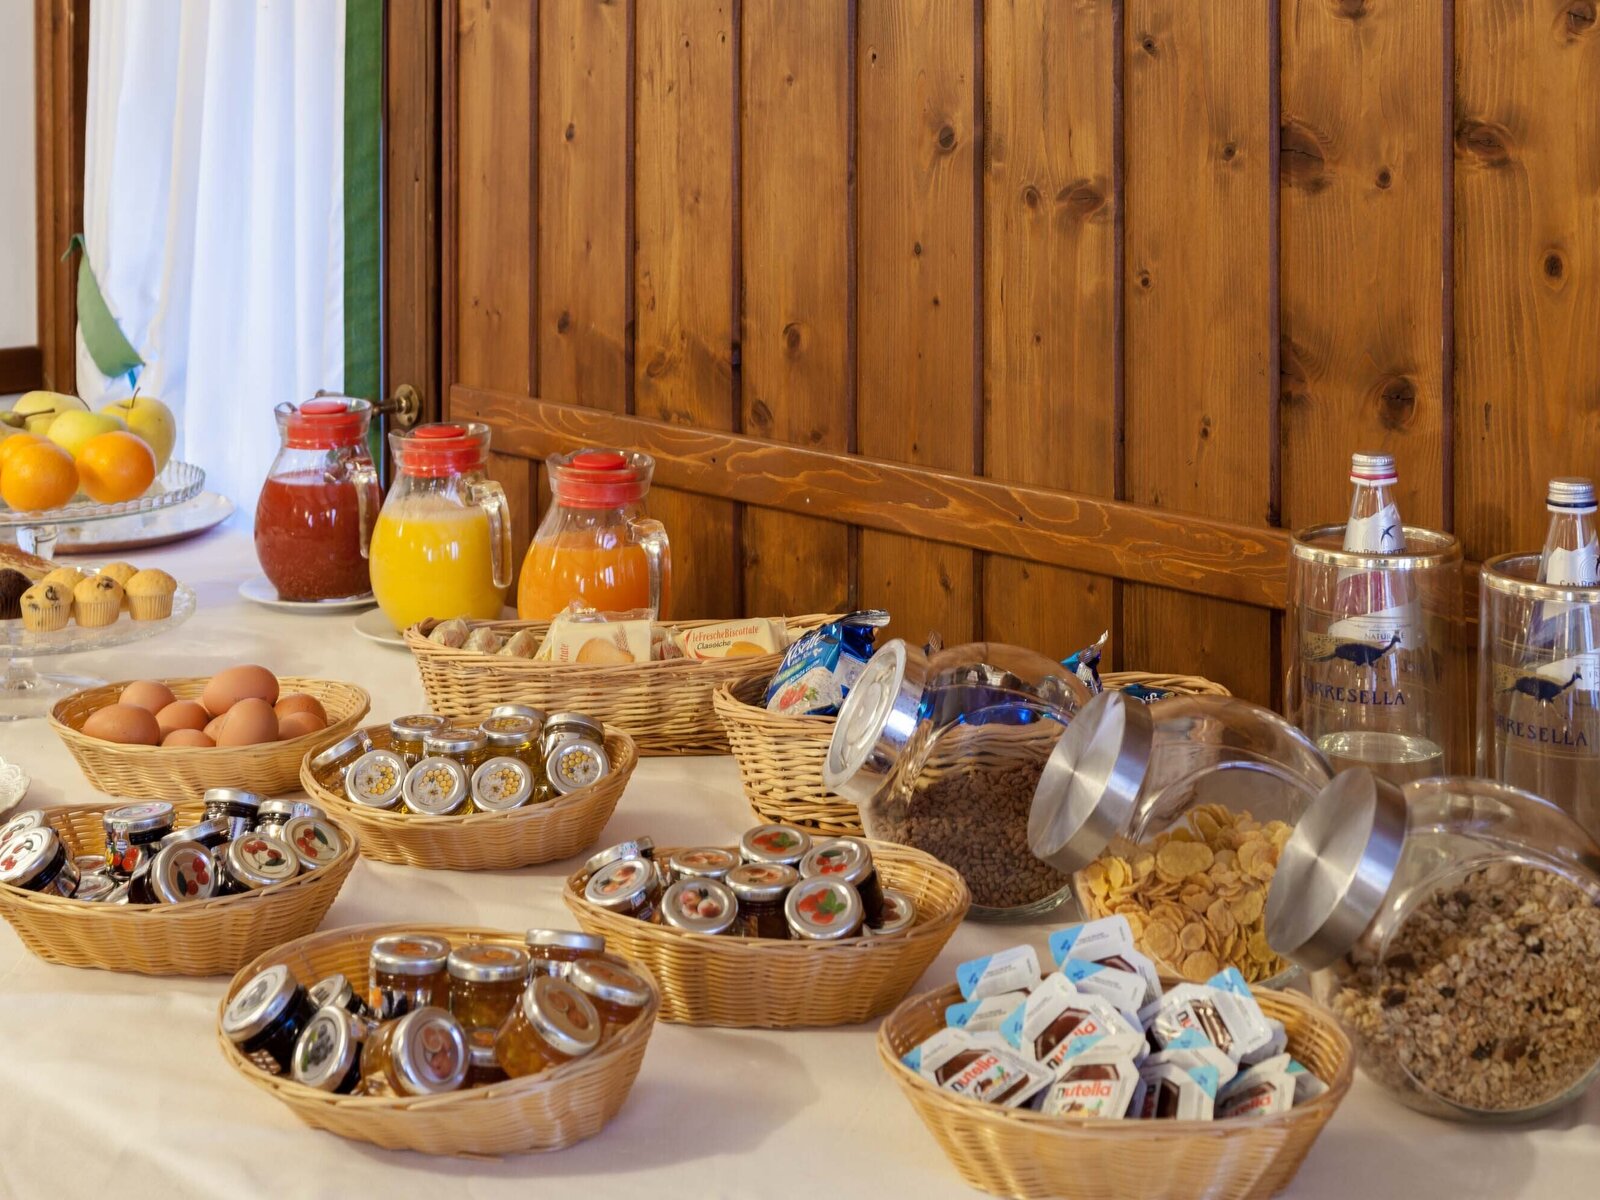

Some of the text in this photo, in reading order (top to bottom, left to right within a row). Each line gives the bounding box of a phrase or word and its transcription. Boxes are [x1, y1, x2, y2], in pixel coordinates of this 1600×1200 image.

[696, 640, 732, 650] Classiche
[1364, 632, 1406, 640] NATURE
[1496, 713, 1588, 747] RRESELLA
[950, 1055, 1000, 1092] nutella
[1056, 1081, 1112, 1099] nutella
